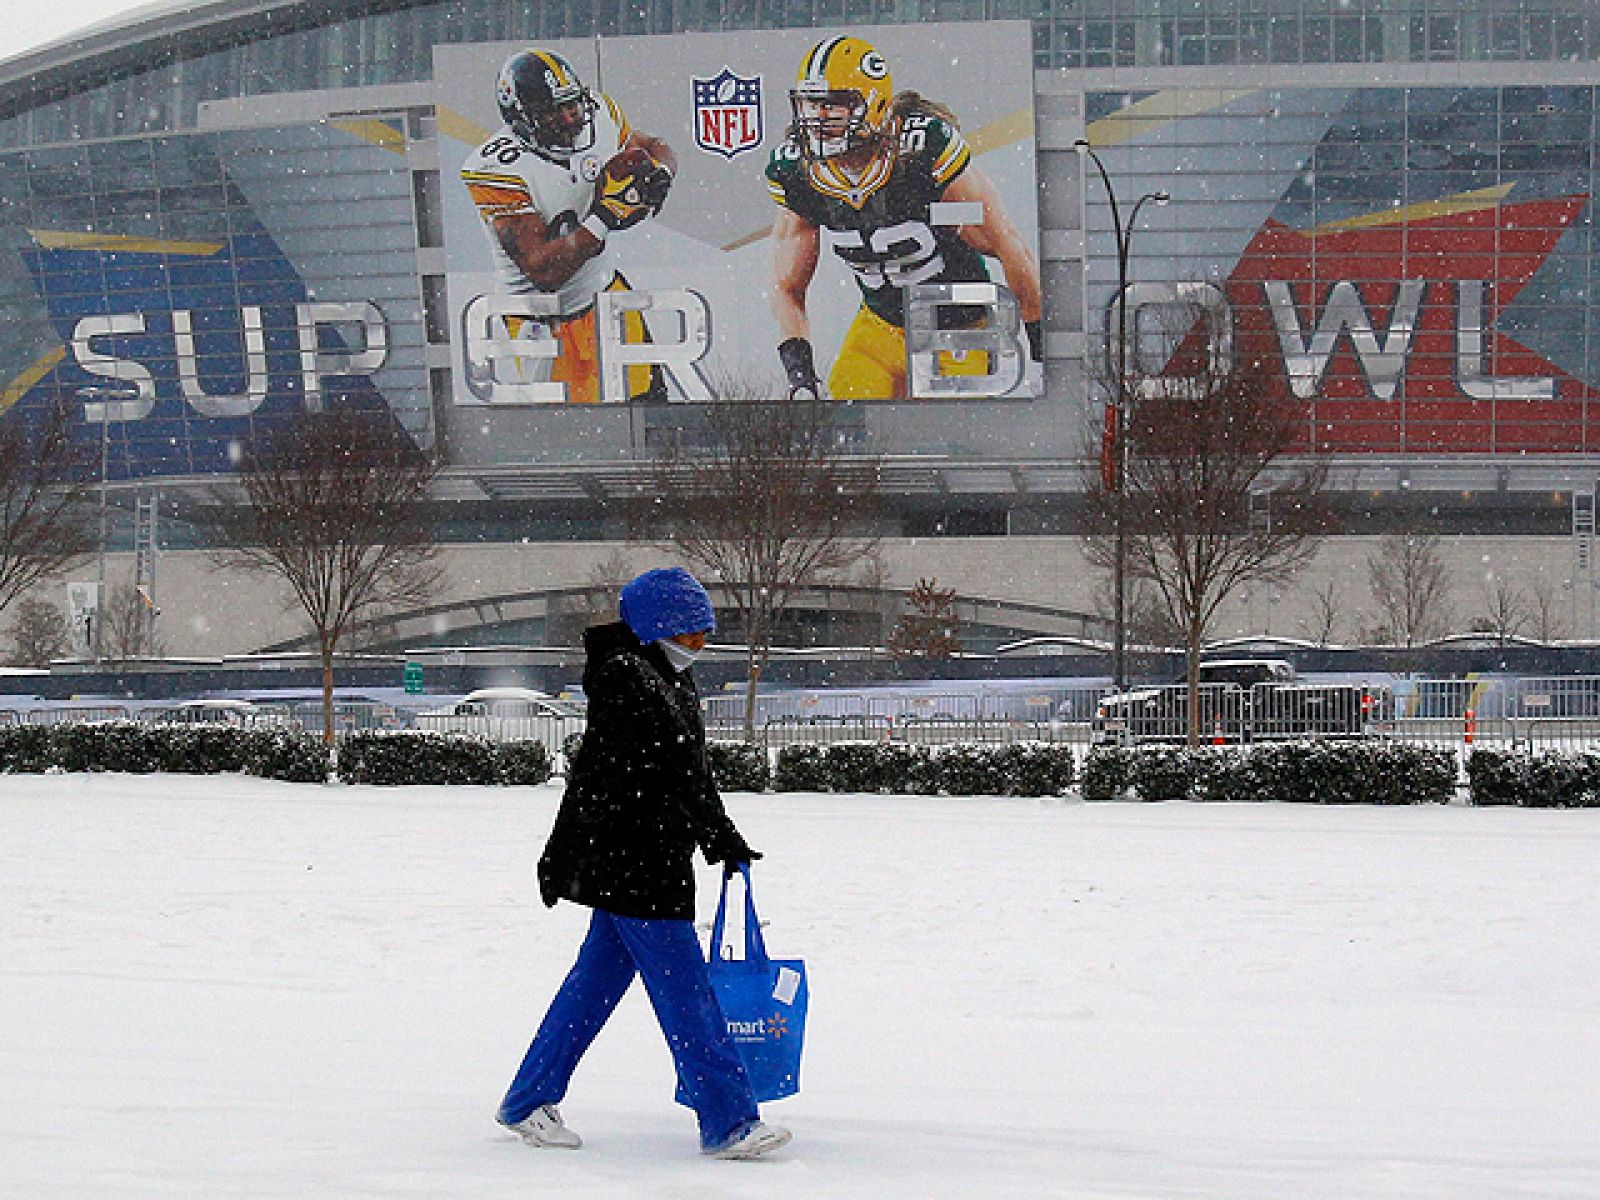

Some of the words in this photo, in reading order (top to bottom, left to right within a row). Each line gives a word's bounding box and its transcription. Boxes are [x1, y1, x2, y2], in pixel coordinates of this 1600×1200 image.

[701, 108, 756, 149] NFL
[71, 288, 718, 423] SUPER
[905, 279, 1556, 401] BOWL
